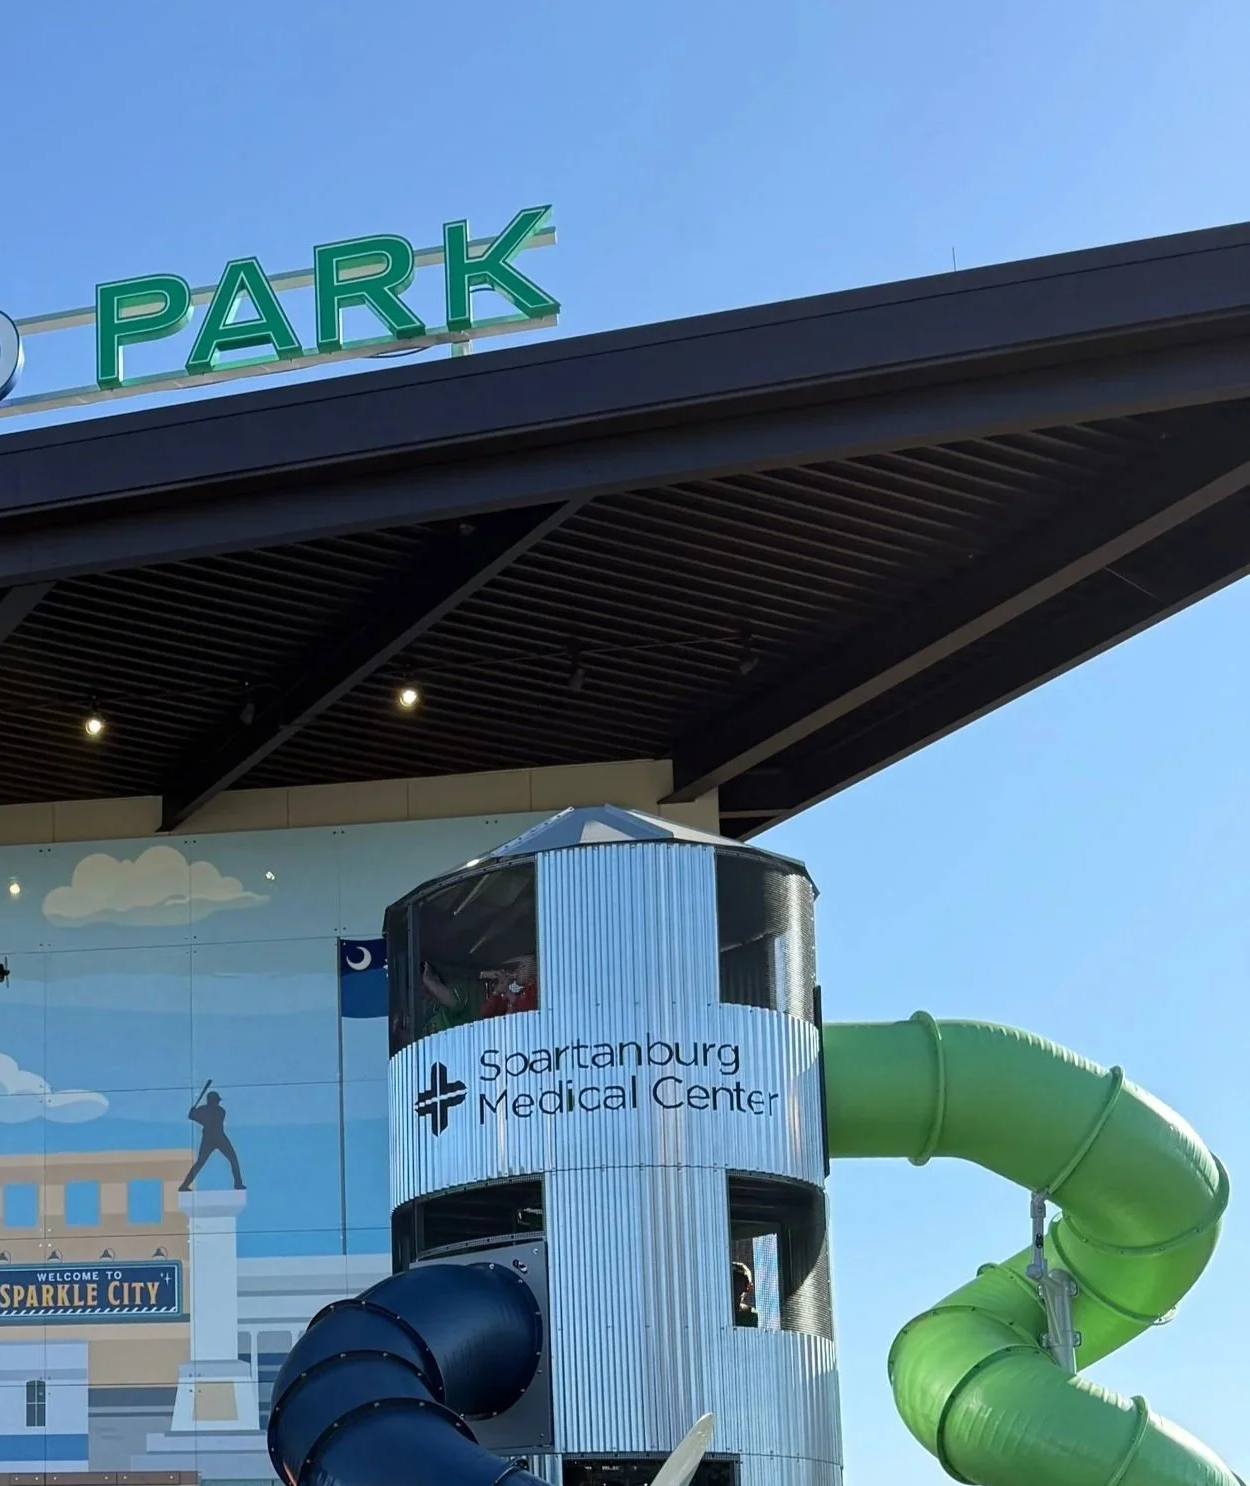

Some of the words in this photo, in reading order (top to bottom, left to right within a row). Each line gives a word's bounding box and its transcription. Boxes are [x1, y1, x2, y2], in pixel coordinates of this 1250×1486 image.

[95, 204, 561, 389] PARK
[479, 1032, 740, 1082] Spartanburg
[479, 1075, 638, 1125] Medical
[652, 1076, 780, 1118] Center
[0, 1283, 98, 1309] SPARKLE
[107, 1280, 160, 1306] CITY
[37, 1271, 99, 1282] WELCOME
[106, 1271, 123, 1280] TO
